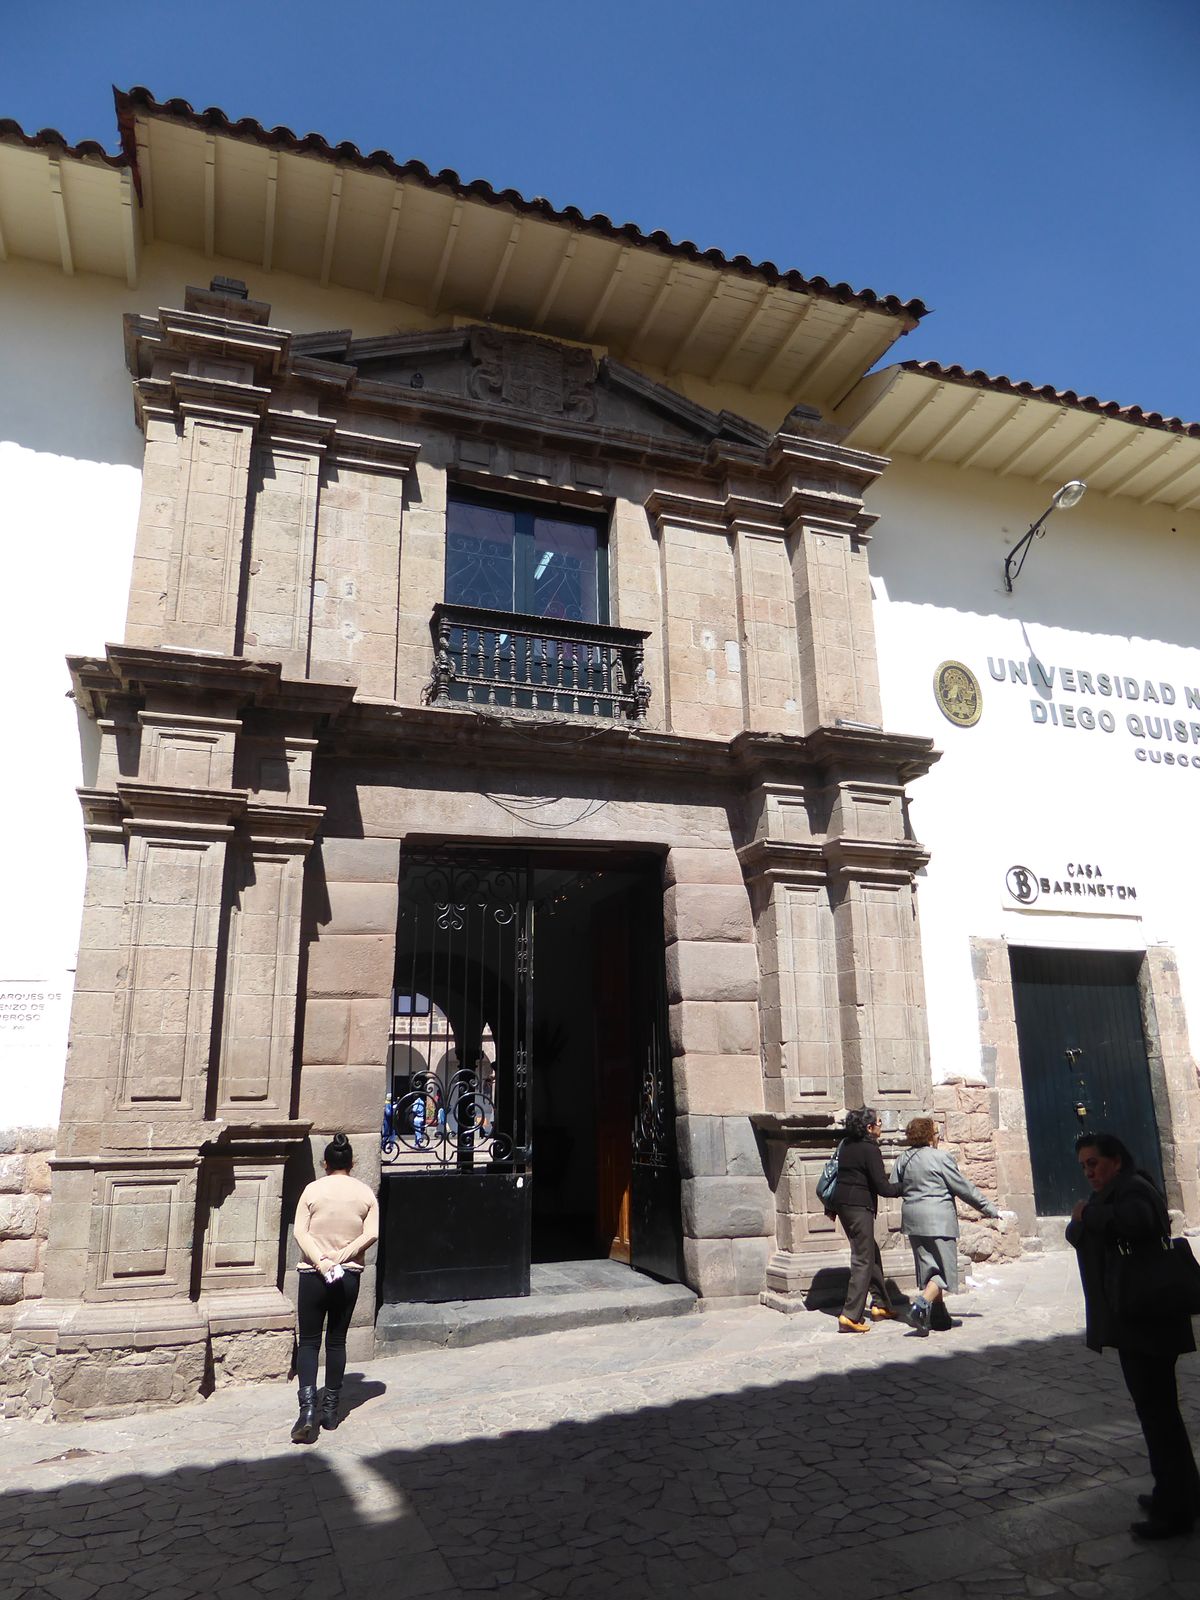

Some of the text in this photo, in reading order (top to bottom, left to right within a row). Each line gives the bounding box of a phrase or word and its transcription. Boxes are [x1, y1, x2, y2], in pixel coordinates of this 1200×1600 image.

[986, 656, 1176, 705] UNIVERSIDAD
[1029, 699, 1116, 733] DIEGO
[1134, 747, 1200, 769] CUSCO
[1066, 862, 1103, 879] CASA
[1039, 877, 1137, 900] BARRINGTON
